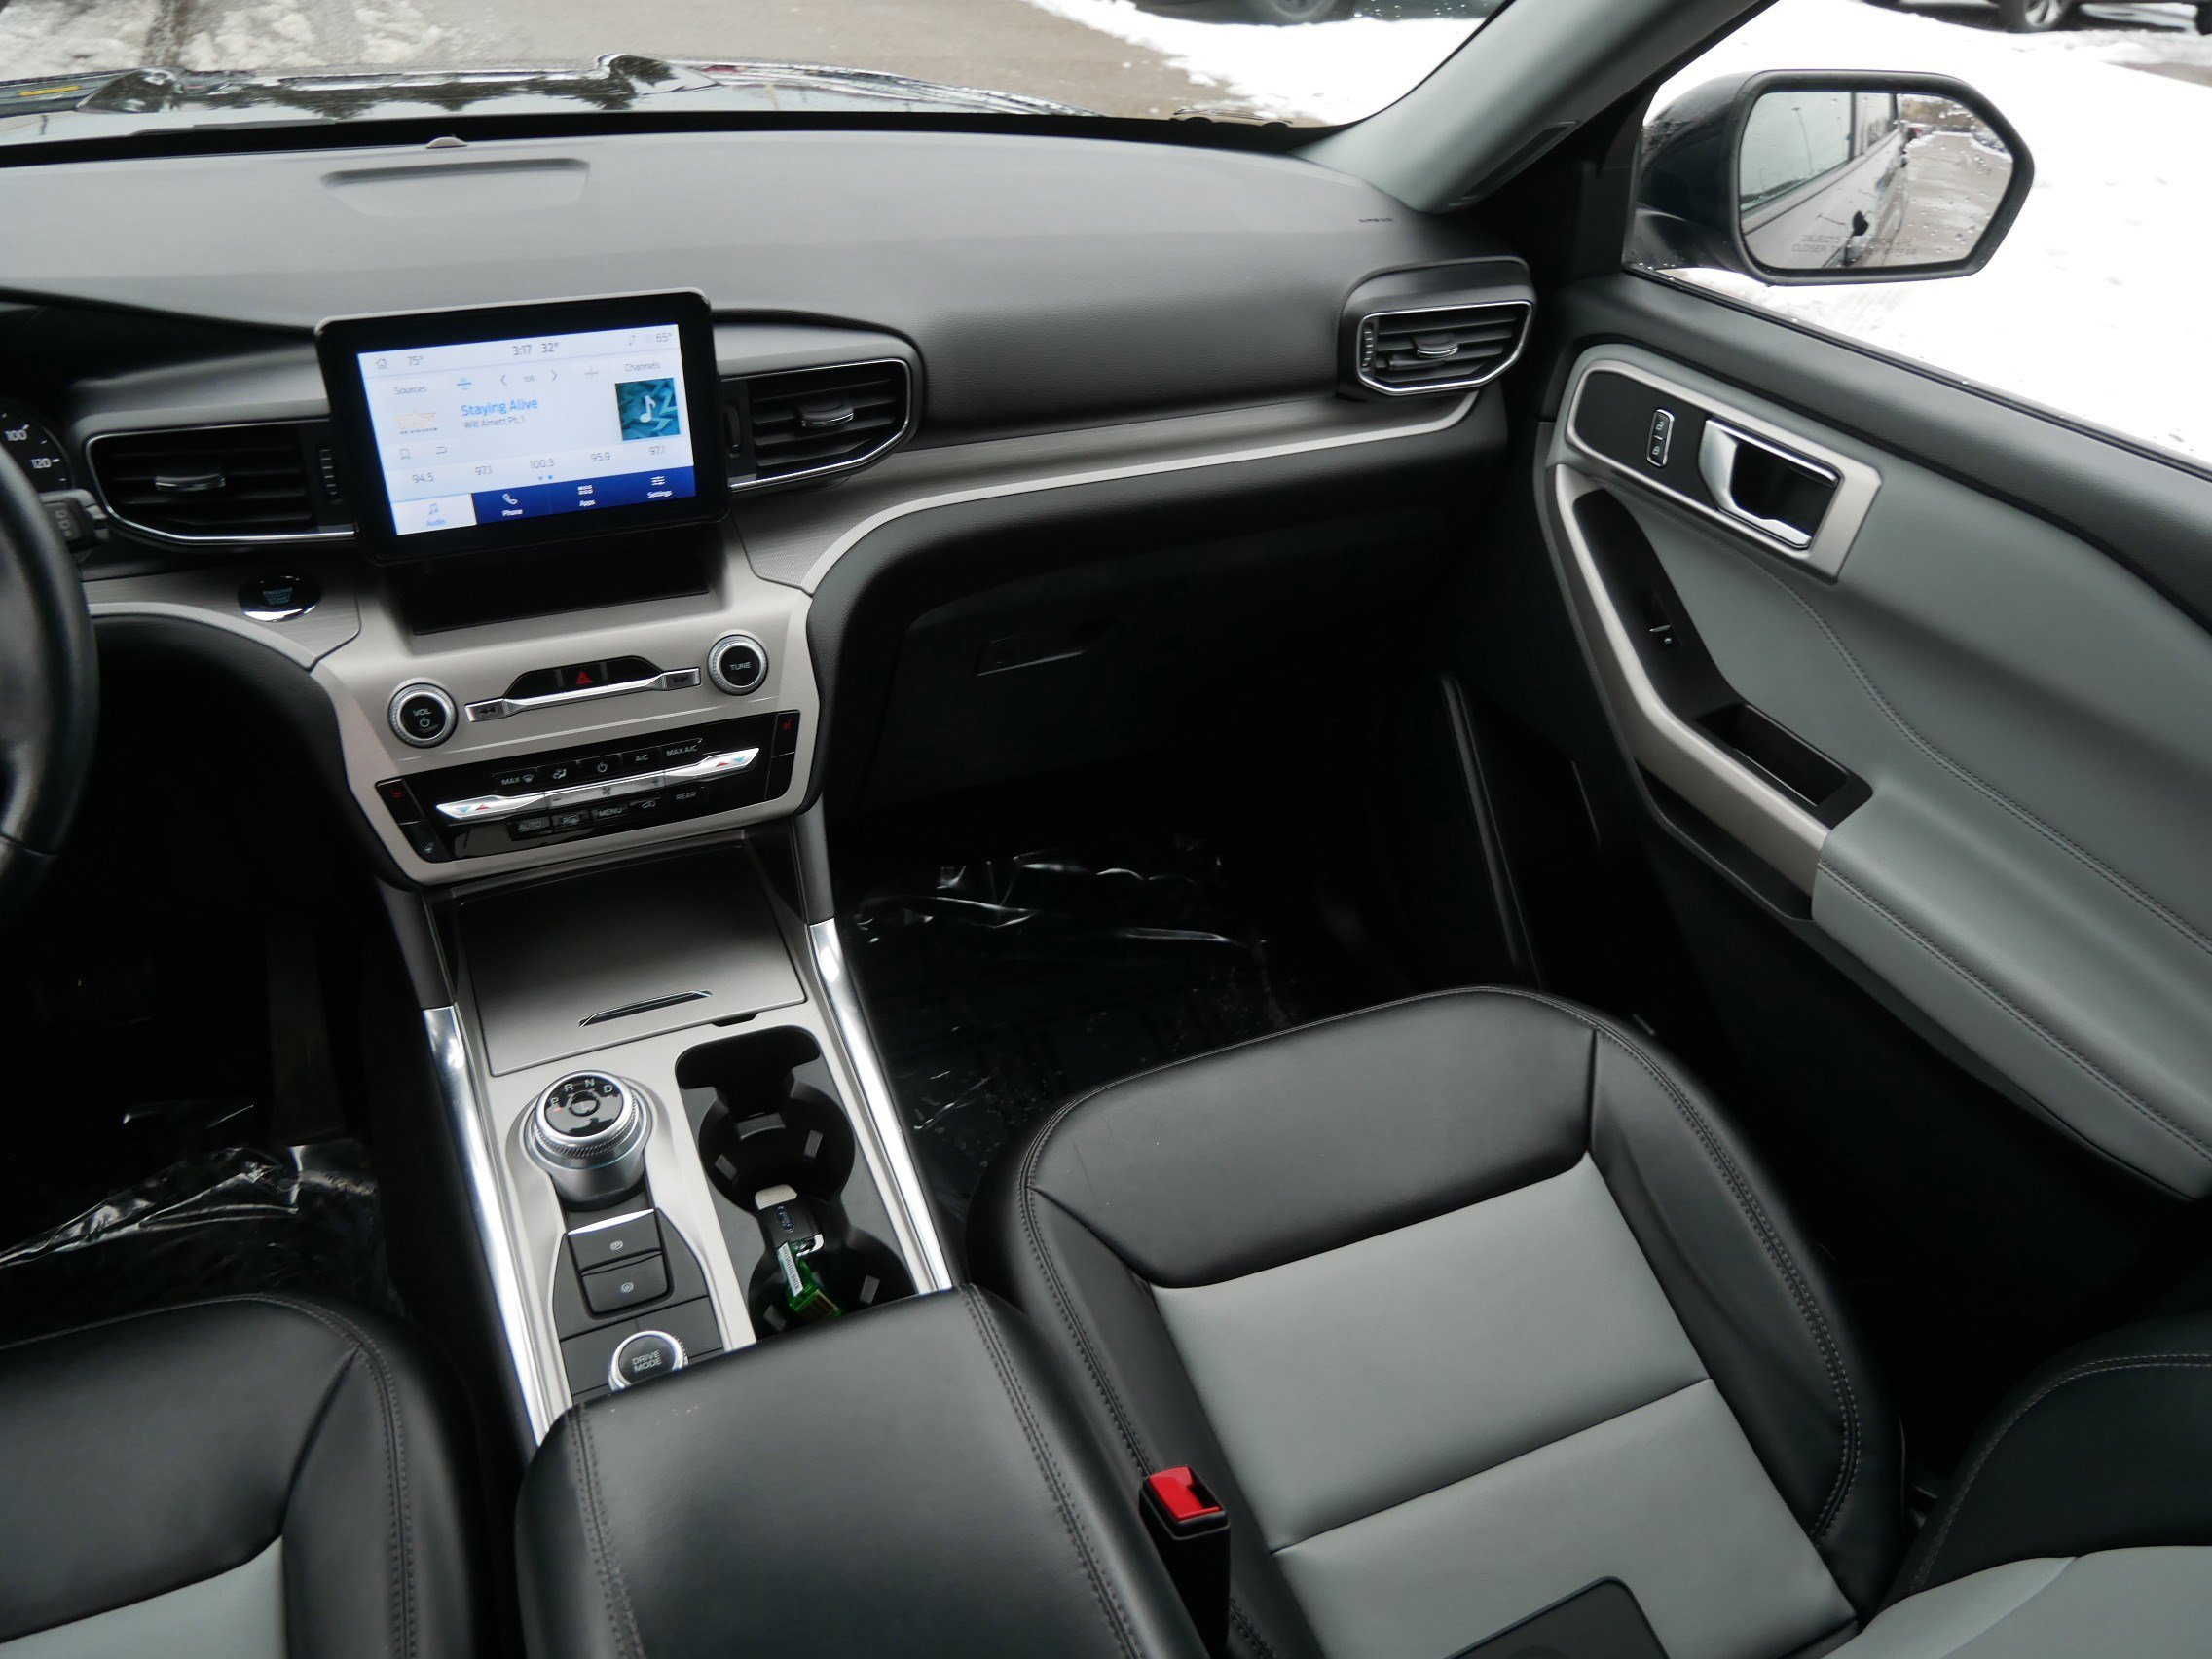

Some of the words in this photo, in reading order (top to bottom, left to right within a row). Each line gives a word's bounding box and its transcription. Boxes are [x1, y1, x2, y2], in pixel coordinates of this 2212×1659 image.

[541, 342, 559, 354] 32°
[624, 360, 661, 373] Channels
[393, 385, 428, 396] Sources
[460, 402, 507, 418] Staying
[509, 398, 538, 411] Alive
[4, 429, 27, 441] 100
[30, 457, 52, 469] 120
[412, 471, 435, 485] 94.5
[646, 489, 674, 499] Settings
[579, 498, 596, 507] Apps
[501, 508, 524, 518] Phone
[729, 661, 753, 670] TUNE
[412, 708, 432, 717] VOL
[500, 777, 522, 787] MAX
[675, 791, 697, 801] REAR
[598, 806, 624, 819] MENU
[517, 820, 542, 833] AUTO
[564, 1082, 575, 1093] R
[584, 1077, 597, 1088] N
[603, 1084, 614, 1094] D
[550, 1096, 561, 1106] P
[632, 1350, 661, 1365] DRIVE
[634, 1357, 663, 1372] MODE
